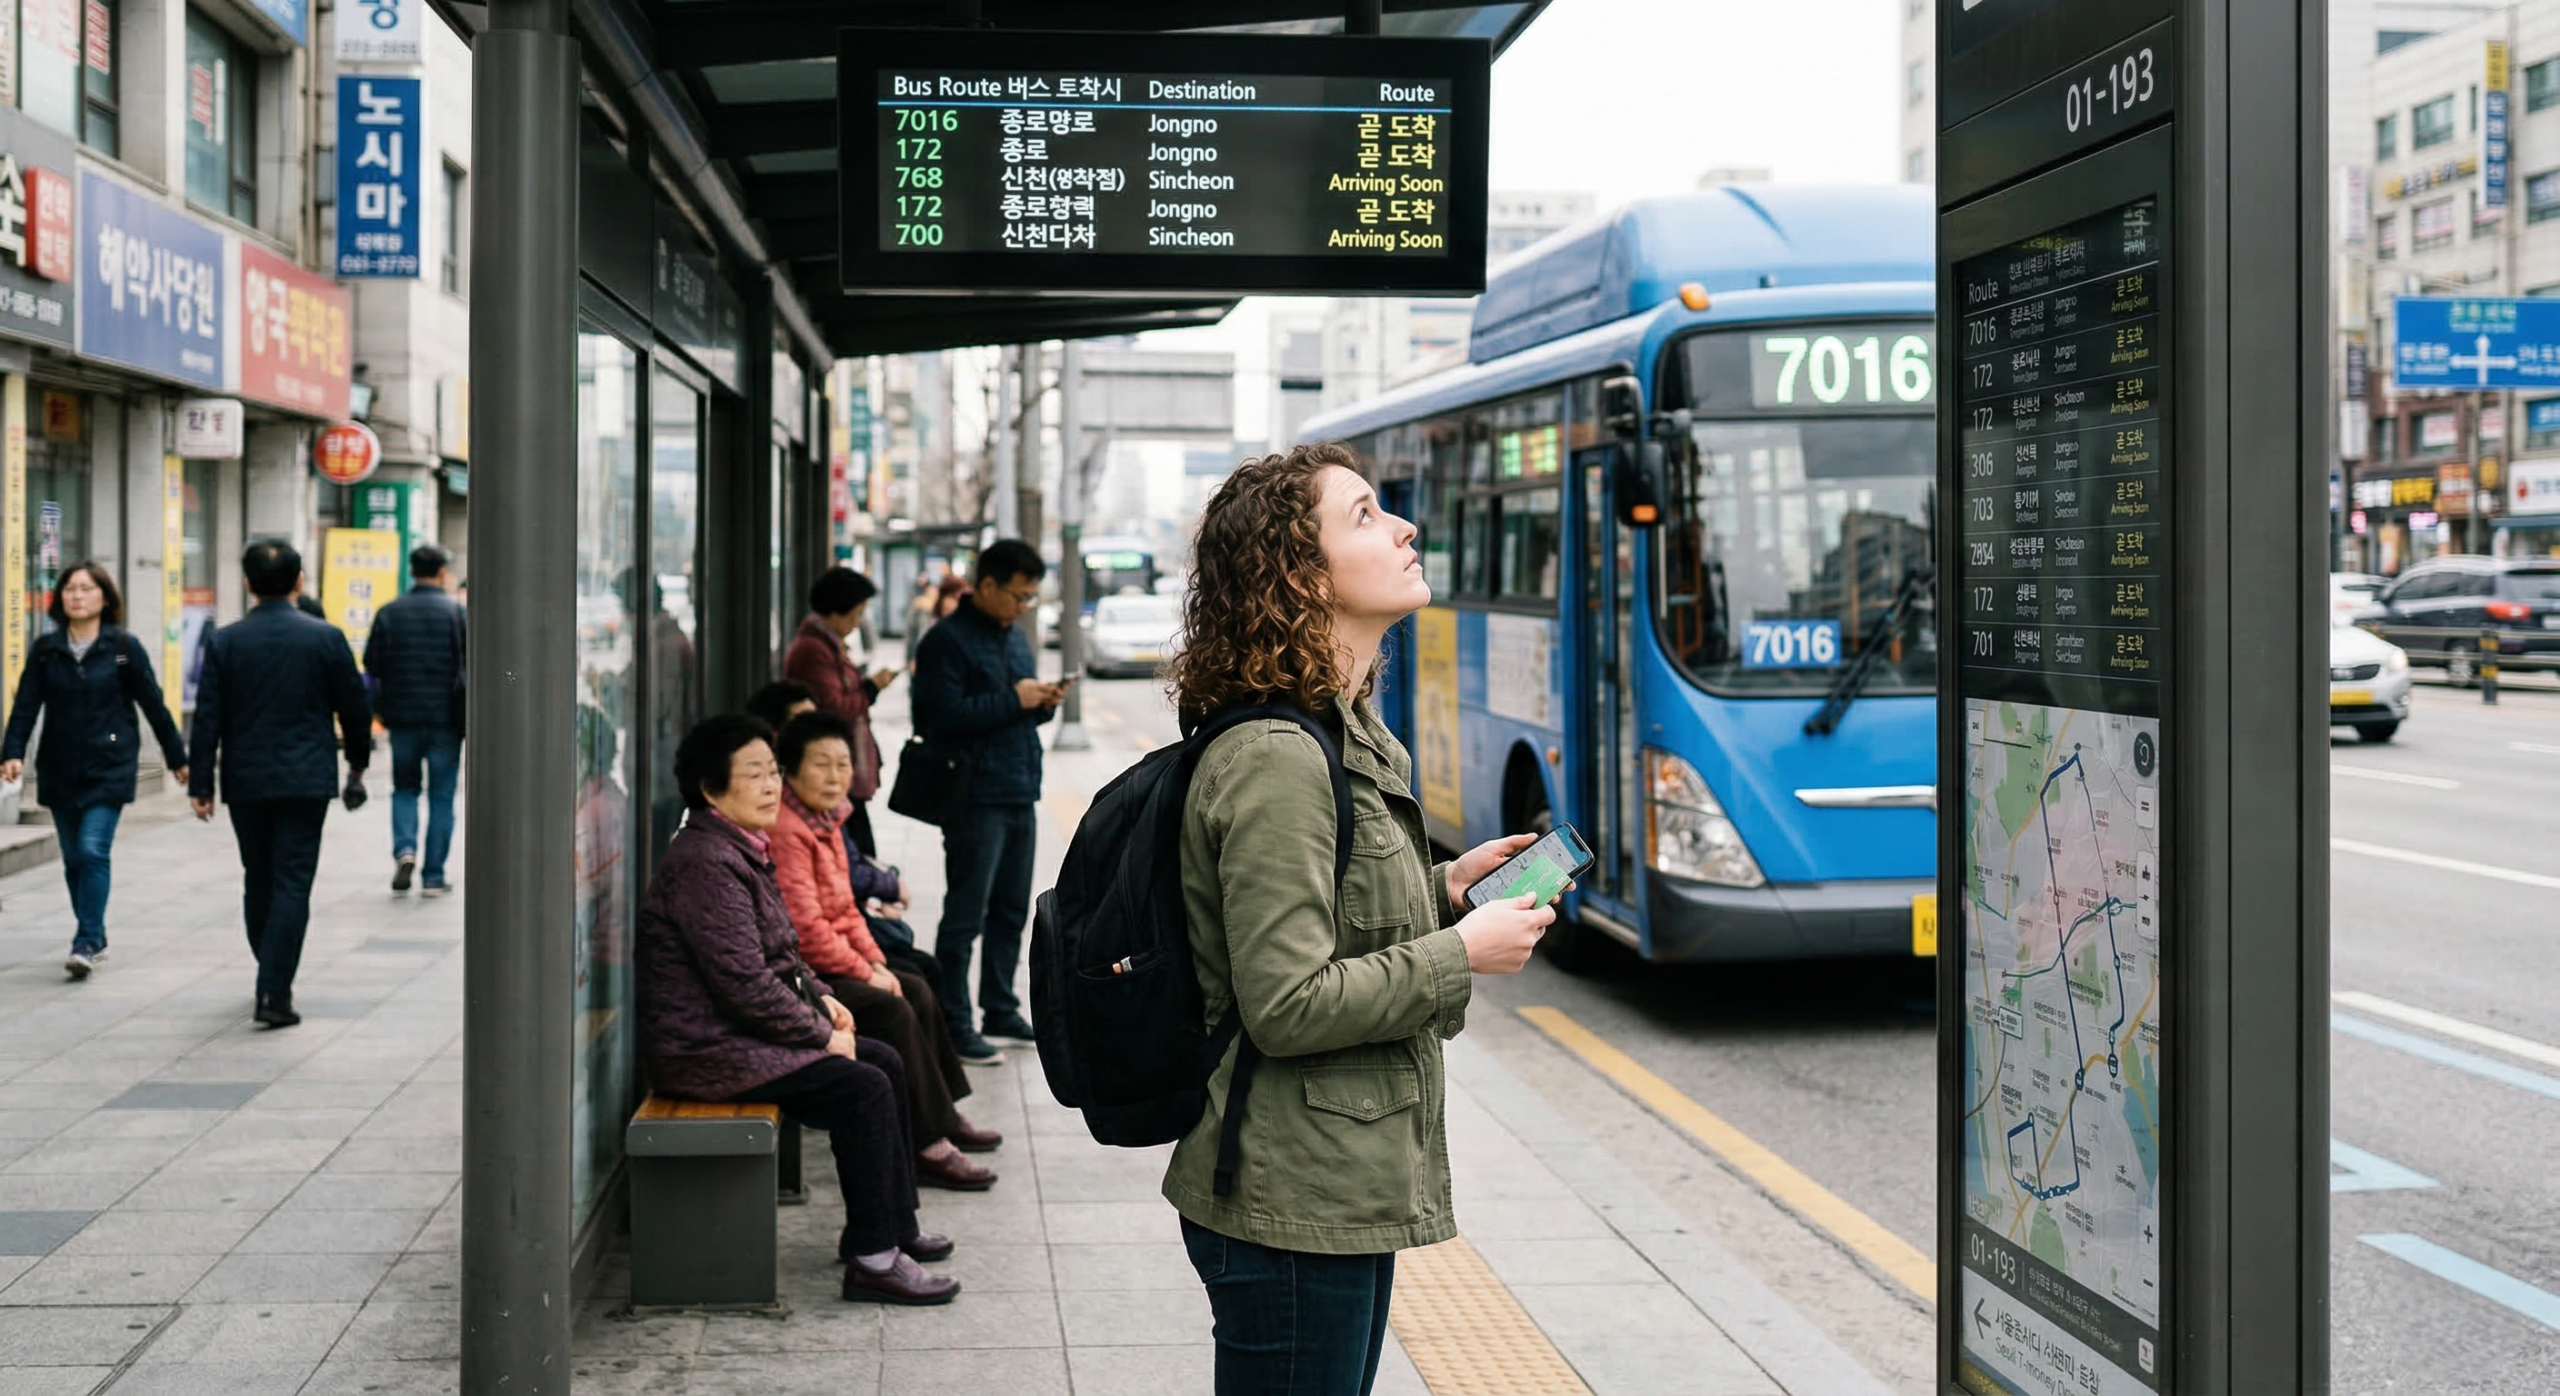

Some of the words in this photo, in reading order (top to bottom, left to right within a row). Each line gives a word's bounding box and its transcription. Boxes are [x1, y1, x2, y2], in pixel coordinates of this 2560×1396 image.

[894, 76, 932, 96] Bus
[939, 77, 1002, 96] Route
[1008, 76, 1051, 100] 버스
[1056, 77, 1122, 101] 토착시
[1149, 80, 1257, 100] Destination
[1380, 82, 1436, 102] Route
[2066, 47, 2155, 133] 01-193
[895, 109, 958, 131] 7016
[1148, 114, 1218, 138] Jongno
[1357, 113, 1382, 139] 곧
[1388, 114, 1436, 141] 도착
[355, 81, 408, 229] 노시마
[897, 138, 942, 159] 172
[1000, 137, 1049, 163] 종로
[1148, 143, 1218, 167] Jongno
[1357, 143, 1382, 169] 곧
[1388, 143, 1436, 170] 도착
[895, 167, 944, 188] 768
[1149, 170, 1235, 191] Sincheon
[1328, 172, 1396, 196] Arriving
[1400, 173, 1444, 193] Soon
[897, 195, 943, 217] 172
[1148, 199, 1217, 223] Jongno
[1357, 198, 1382, 225] 곧
[1387, 198, 1436, 225] 도착
[895, 224, 944, 246] 700
[1001, 223, 1097, 249] 신천다차
[1149, 226, 1235, 247] Sincheon
[1328, 229, 1396, 252] Arriving
[1400, 230, 1443, 249] Soon
[1968, 277, 1999, 306] Route
[1968, 316, 1997, 347] 7016
[1765, 335, 1933, 405] 7016
[1972, 362, 1993, 390] 172
[1972, 406, 1993, 431] 172
[1971, 451, 1994, 478] 306
[1972, 496, 1994, 522] 703
[1973, 586, 1994, 612] 172
[1747, 625, 1836, 666] 7016
[1972, 630, 1993, 657] 701
[1971, 1233, 2016, 1286] 01-193
